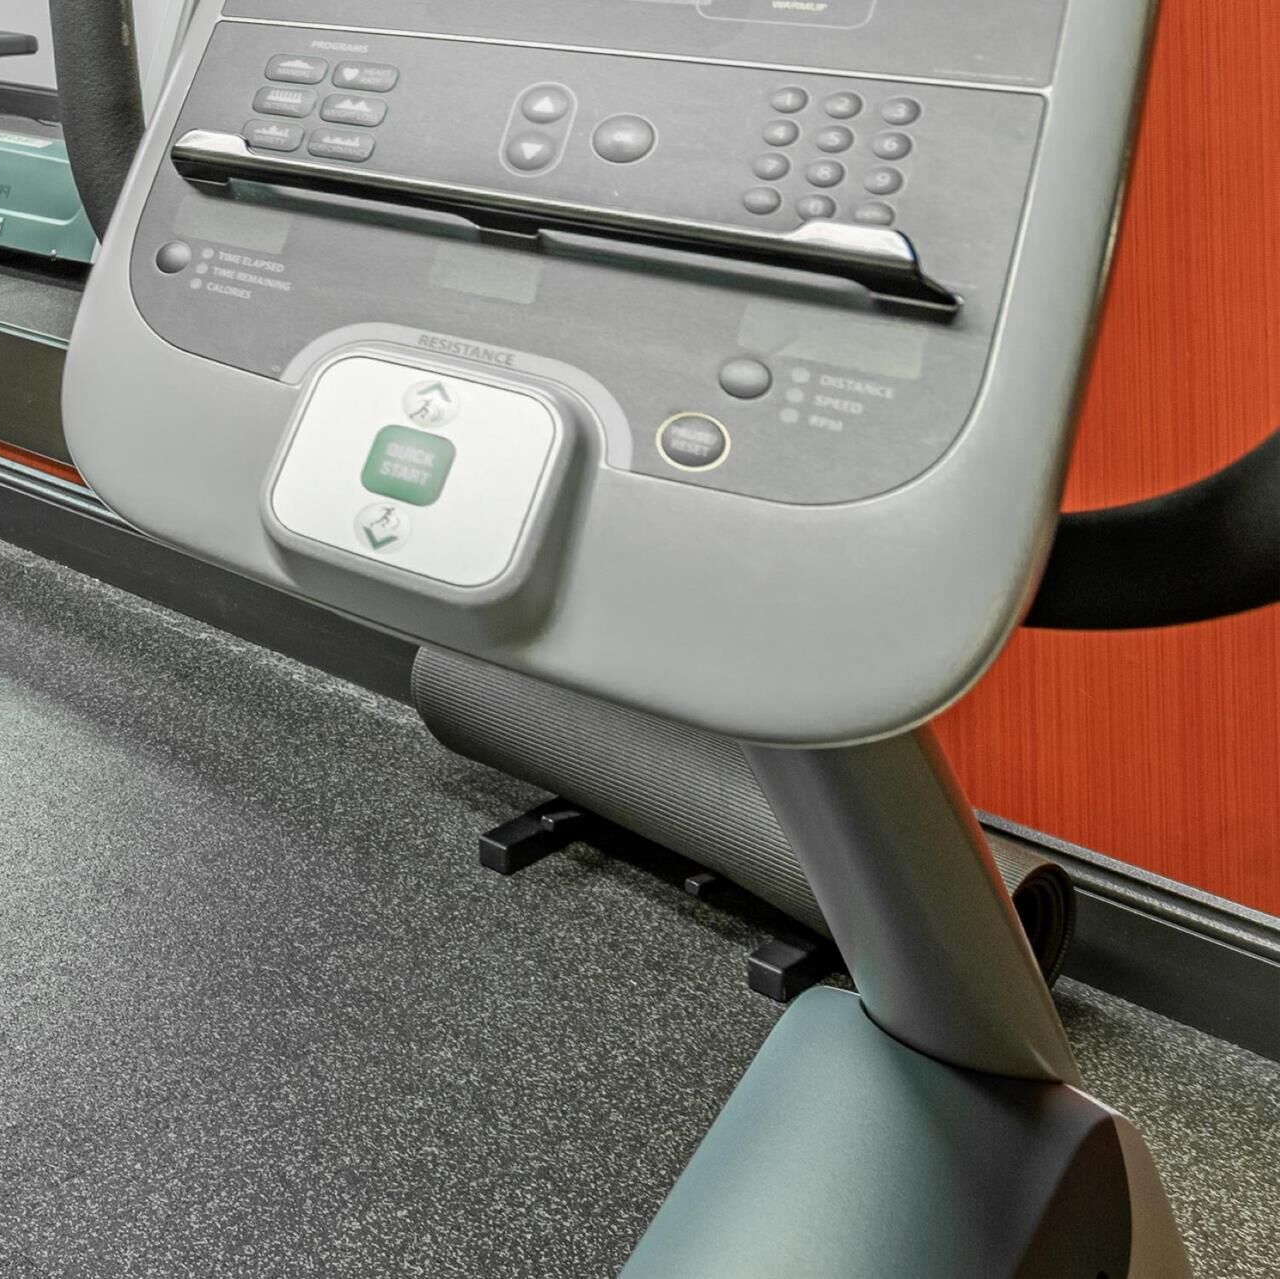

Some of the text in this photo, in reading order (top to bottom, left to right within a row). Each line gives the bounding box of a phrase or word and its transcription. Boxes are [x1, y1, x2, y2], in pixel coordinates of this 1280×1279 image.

[218, 250, 285, 273] TIME ELAPSED
[206, 282, 252, 299] CALORIES
[213, 266, 292, 292] TIME REMAINING
[417, 334, 516, 367] RESISTANCE
[819, 374, 895, 400] DISTANCE
[814, 395, 864, 415] SPEED
[386, 442, 436, 467] QUICK
[380, 461, 432, 487] START
